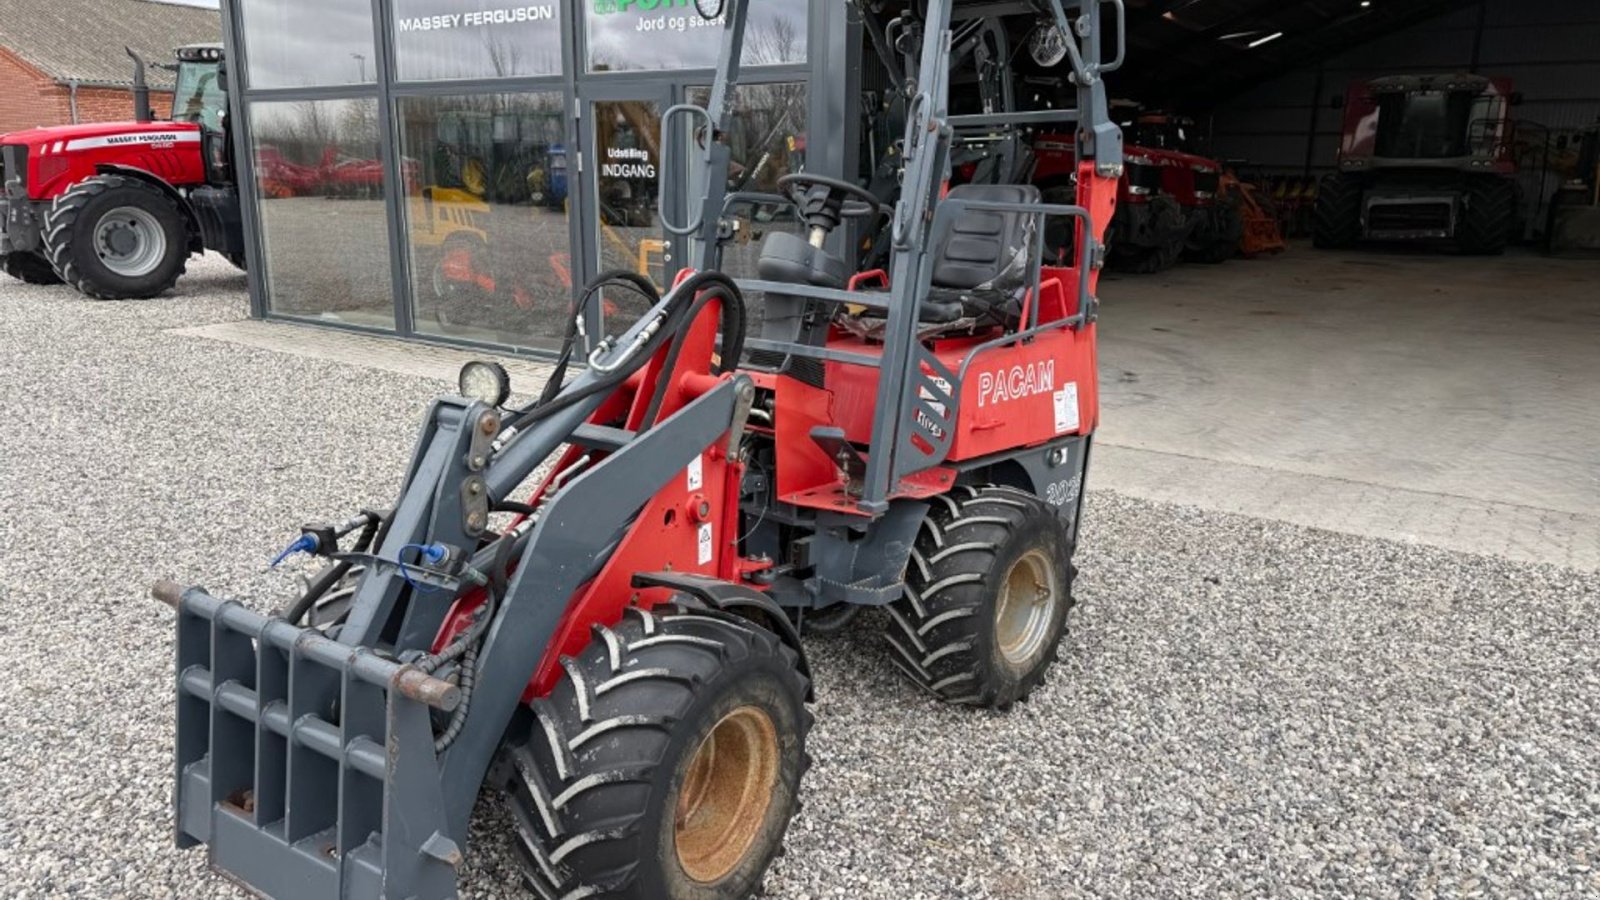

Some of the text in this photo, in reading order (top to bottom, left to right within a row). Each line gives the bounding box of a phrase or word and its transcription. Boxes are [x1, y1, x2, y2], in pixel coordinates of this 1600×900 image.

[399, 5, 552, 32] MASSEY FERGUSON
[635, 15, 666, 32] Jord
[668, 16, 685, 33] og
[607, 147, 649, 162] Udstilling
[602, 164, 656, 178] INDGANG
[978, 359, 1054, 408] PACAM
